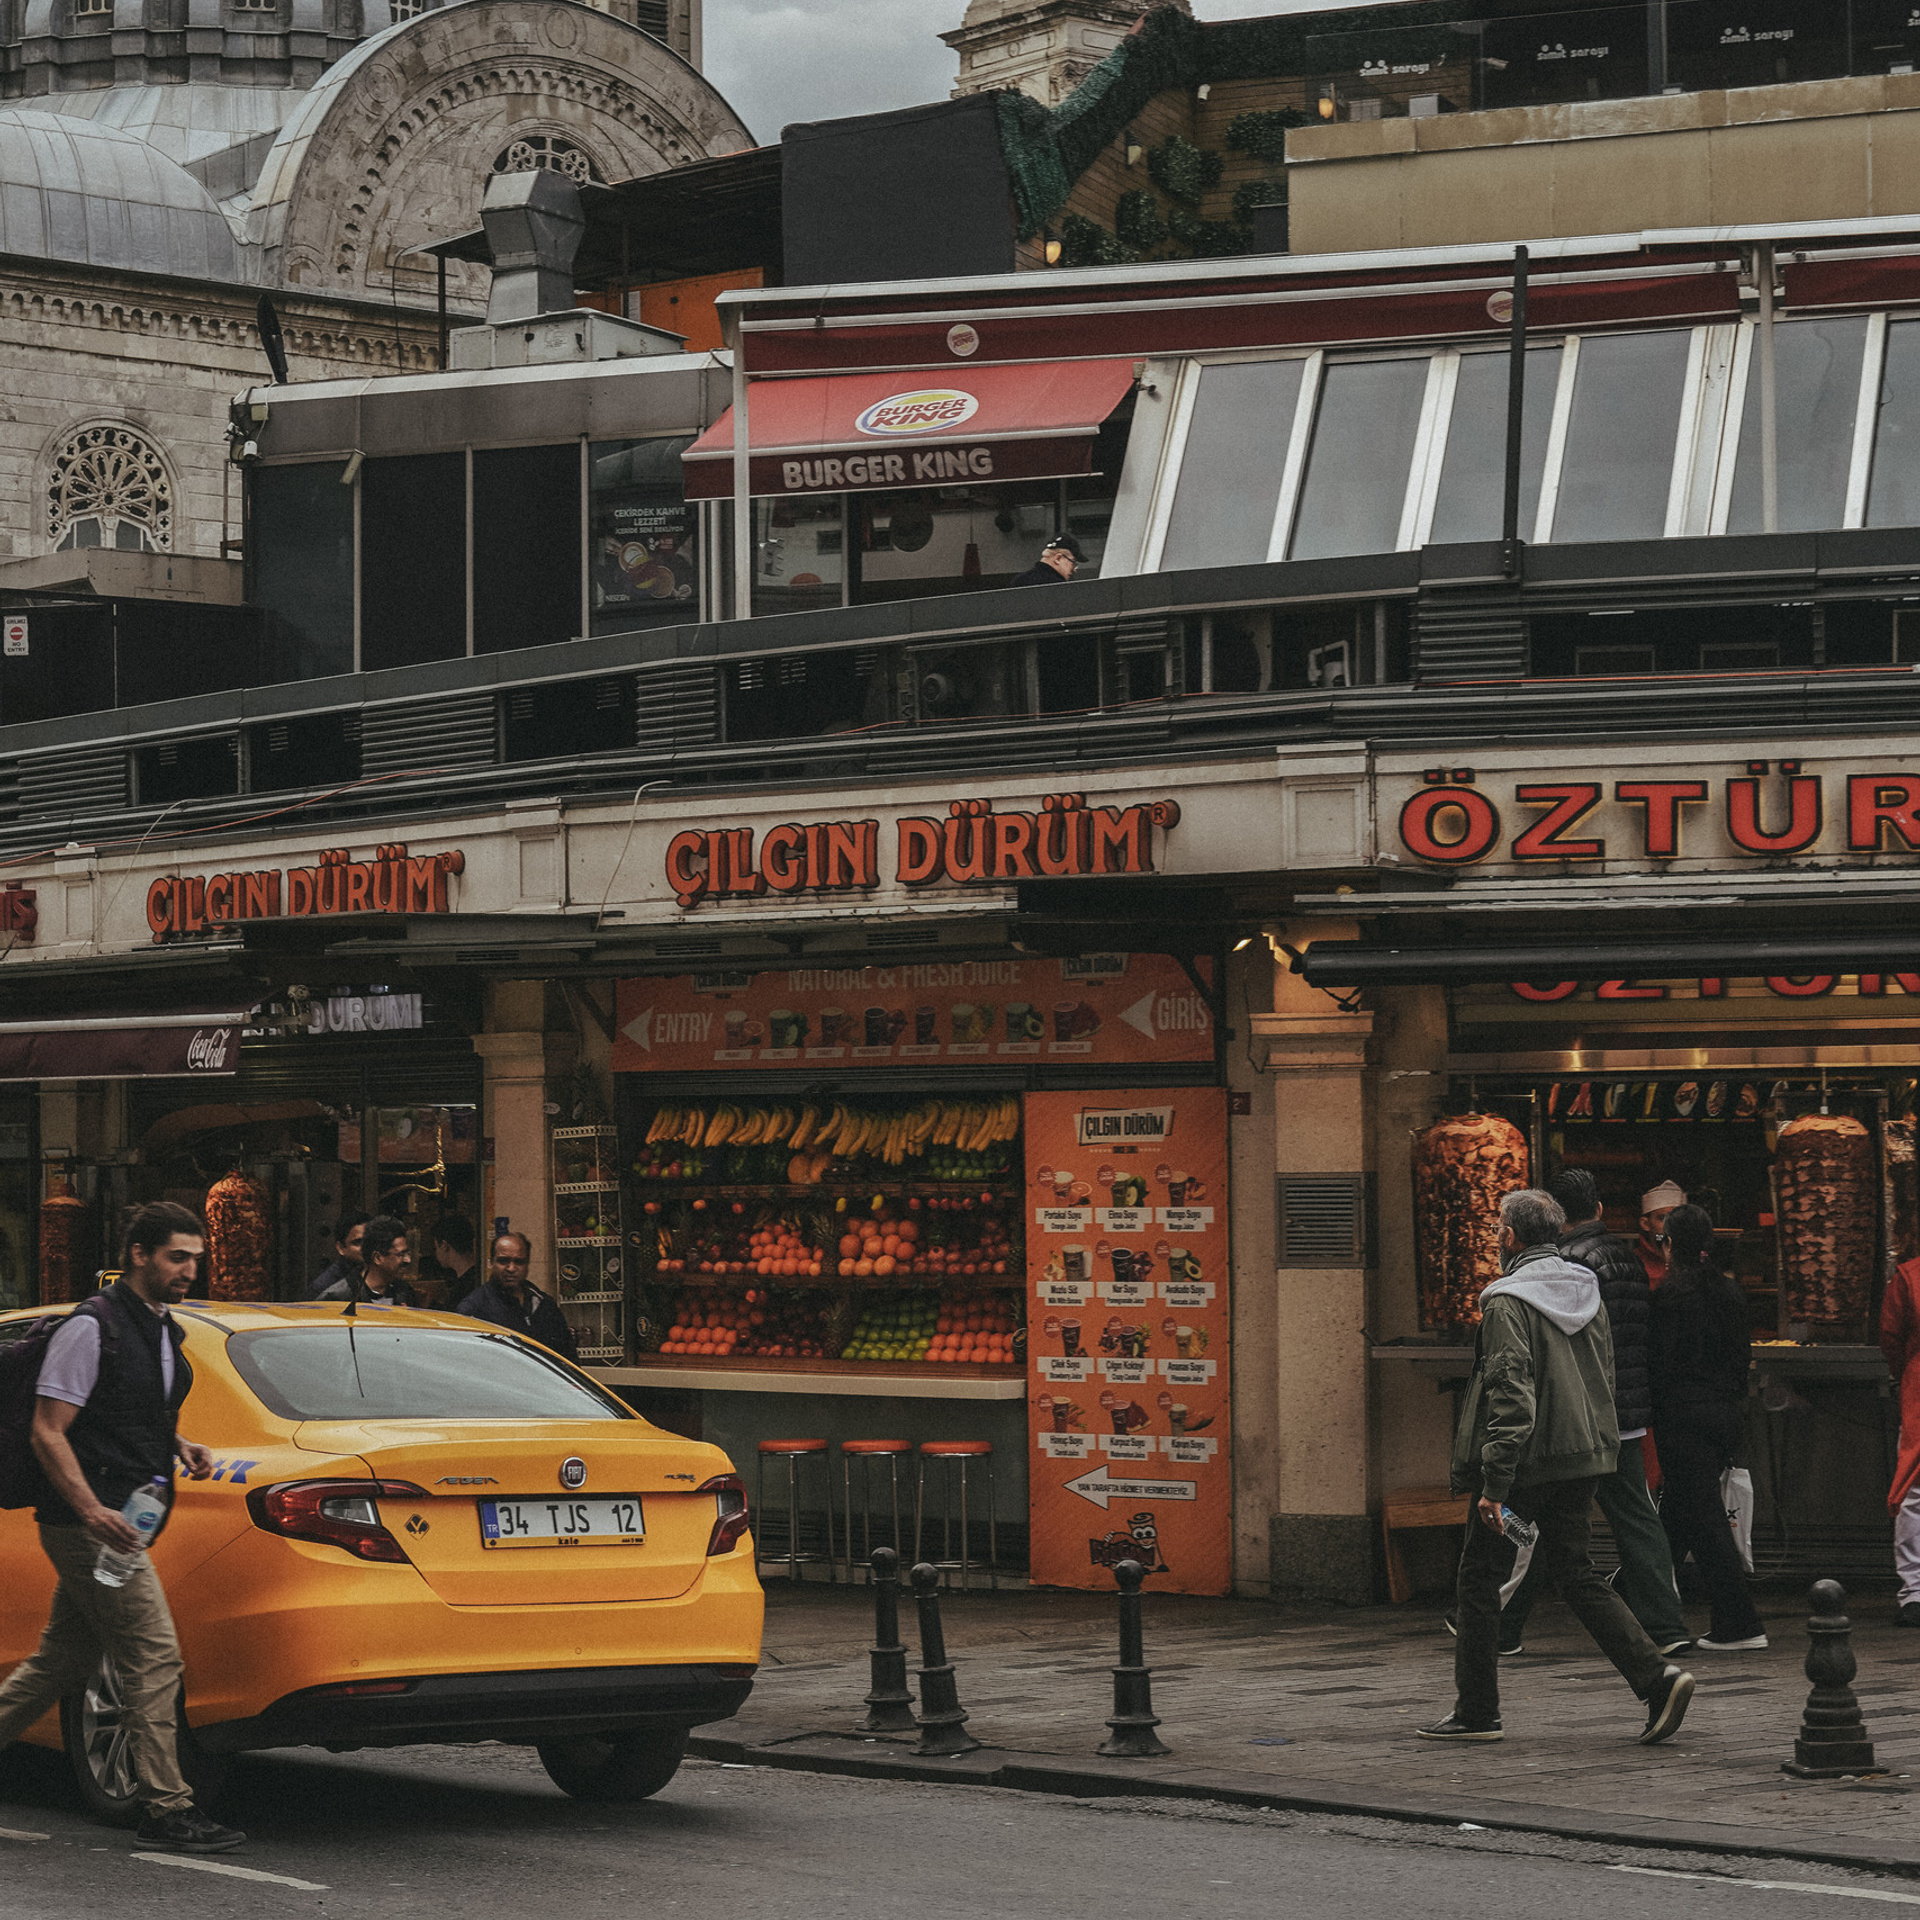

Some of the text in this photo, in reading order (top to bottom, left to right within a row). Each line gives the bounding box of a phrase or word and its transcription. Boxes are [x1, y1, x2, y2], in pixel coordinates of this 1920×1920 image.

[1720, 26, 1750, 44] simit
[1537, 43, 1568, 61] simit
[876, 398, 968, 418] BURGER
[868, 407, 966, 428] KING
[782, 448, 993, 489] BURGER KING
[656, 506, 686, 516] KAHVE
[665, 818, 880, 908] ÇILGIN
[147, 869, 282, 944] ÇILGIN
[789, 961, 1021, 991] NATURAL & FRESH JUICE
[1157, 991, 1208, 1035] GİRİŞ
[655, 1012, 714, 1043] ENTRY
[1085, 1113, 1164, 1139] ÇILGIN DÜRÜM
[1043, 1210, 1082, 1221] Portakal Suyu
[1108, 1210, 1138, 1221] Elma Suyu
[1166, 1209, 1202, 1220] Mango Suyu
[1123, 1285, 1138, 1295] Suyu
[1188, 1285, 1205, 1296] Suyu
[567, 1466, 583, 1480] FIAT
[499, 1504, 637, 1535] 34 TJS 12
[487, 1525, 498, 1533] TR
[558, 1537, 579, 1545] kale
